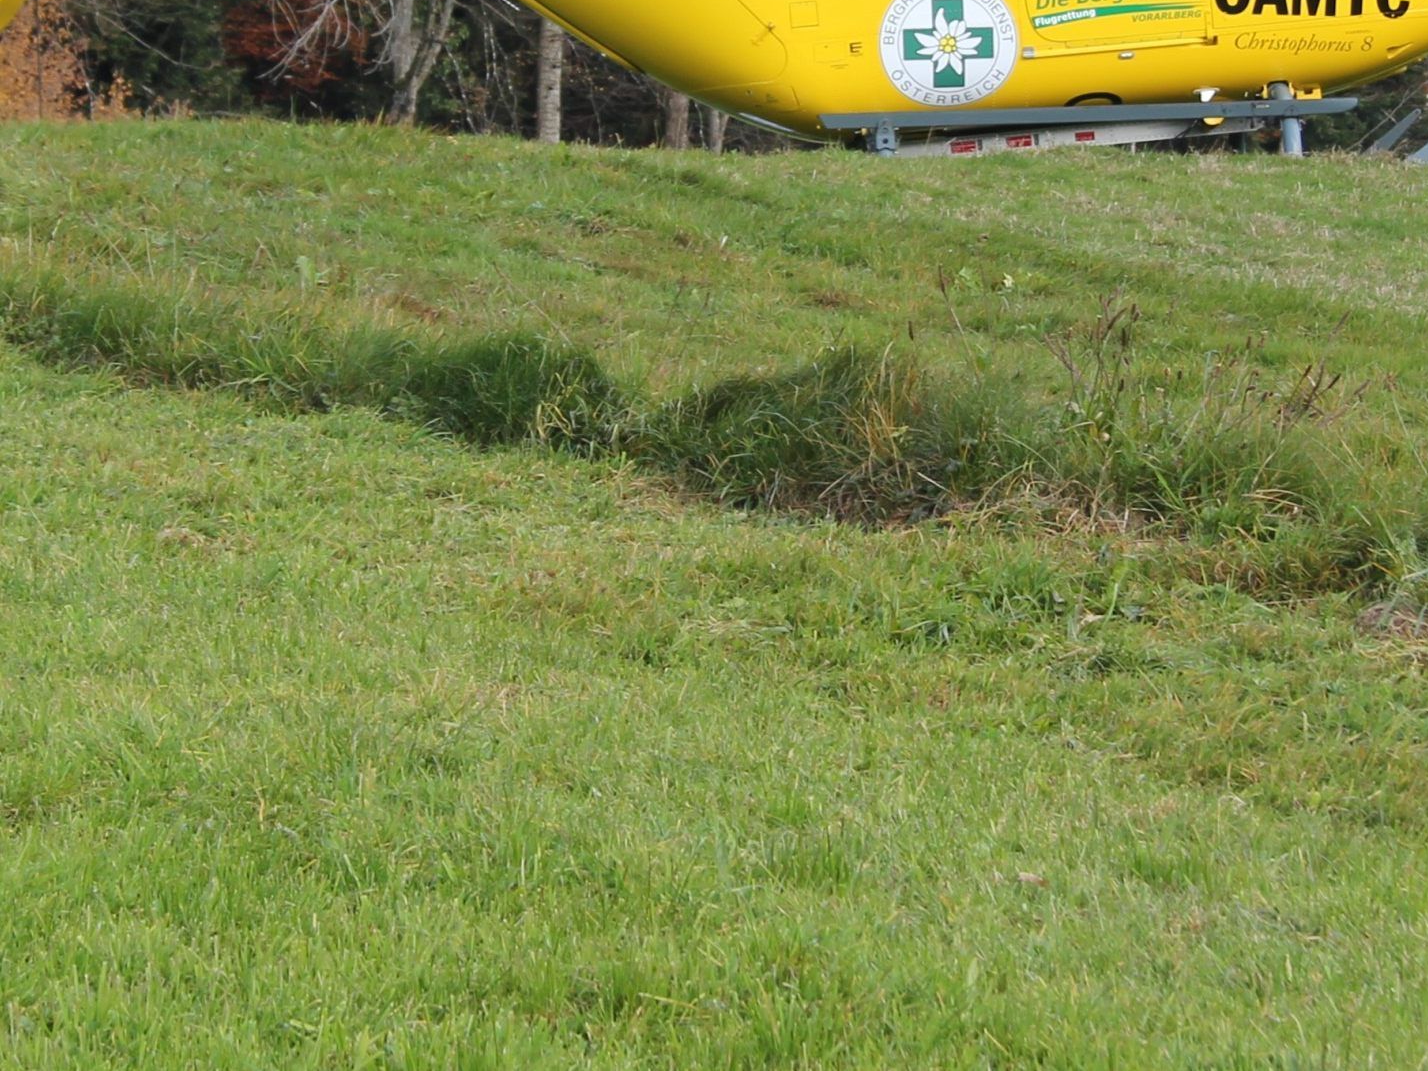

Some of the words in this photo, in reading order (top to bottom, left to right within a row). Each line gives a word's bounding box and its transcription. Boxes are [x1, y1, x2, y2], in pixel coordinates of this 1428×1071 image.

[1034, 8, 1097, 28] Flugrettung
[1132, 9, 1202, 23] VORARLBERG
[1234, 31, 1354, 55] Christophorus
[1360, 35, 1374, 52] 8
[891, 68, 1005, 104] ÖSTERREICH
